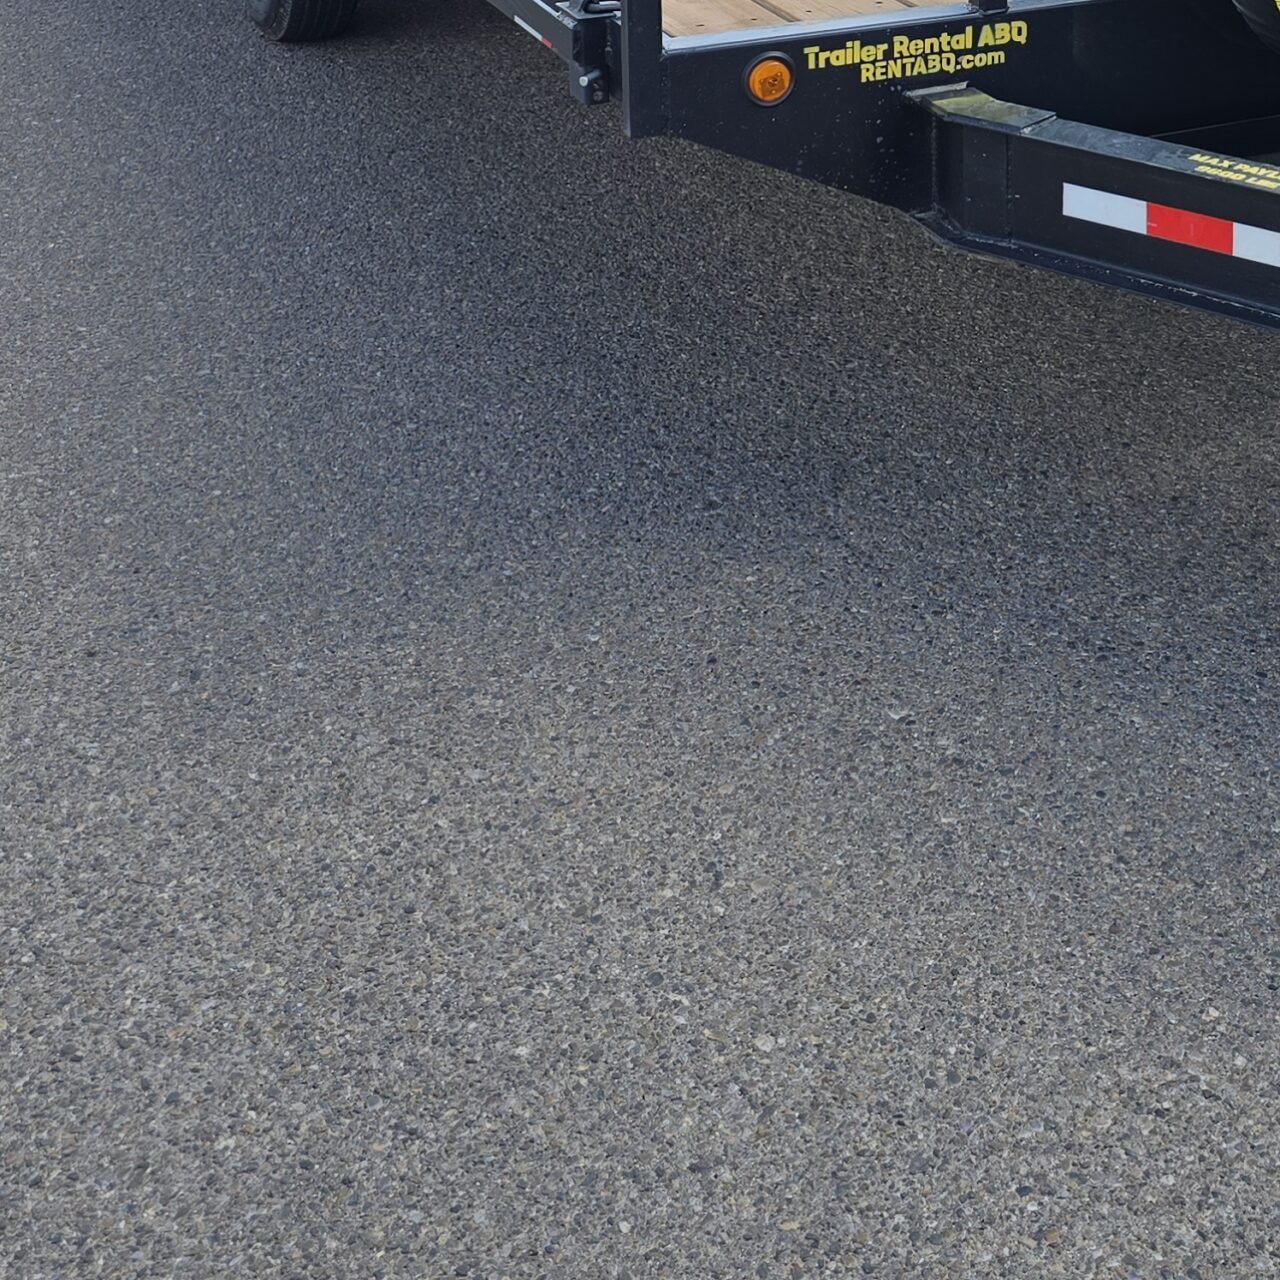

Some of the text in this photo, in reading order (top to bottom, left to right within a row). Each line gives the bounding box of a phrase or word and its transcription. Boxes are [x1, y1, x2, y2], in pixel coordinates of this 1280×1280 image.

[803, 20, 1028, 70] Trailer Rental ABQ
[860, 49, 1005, 83] RENTABQ.com
[1189, 154, 1235, 167] MAX
